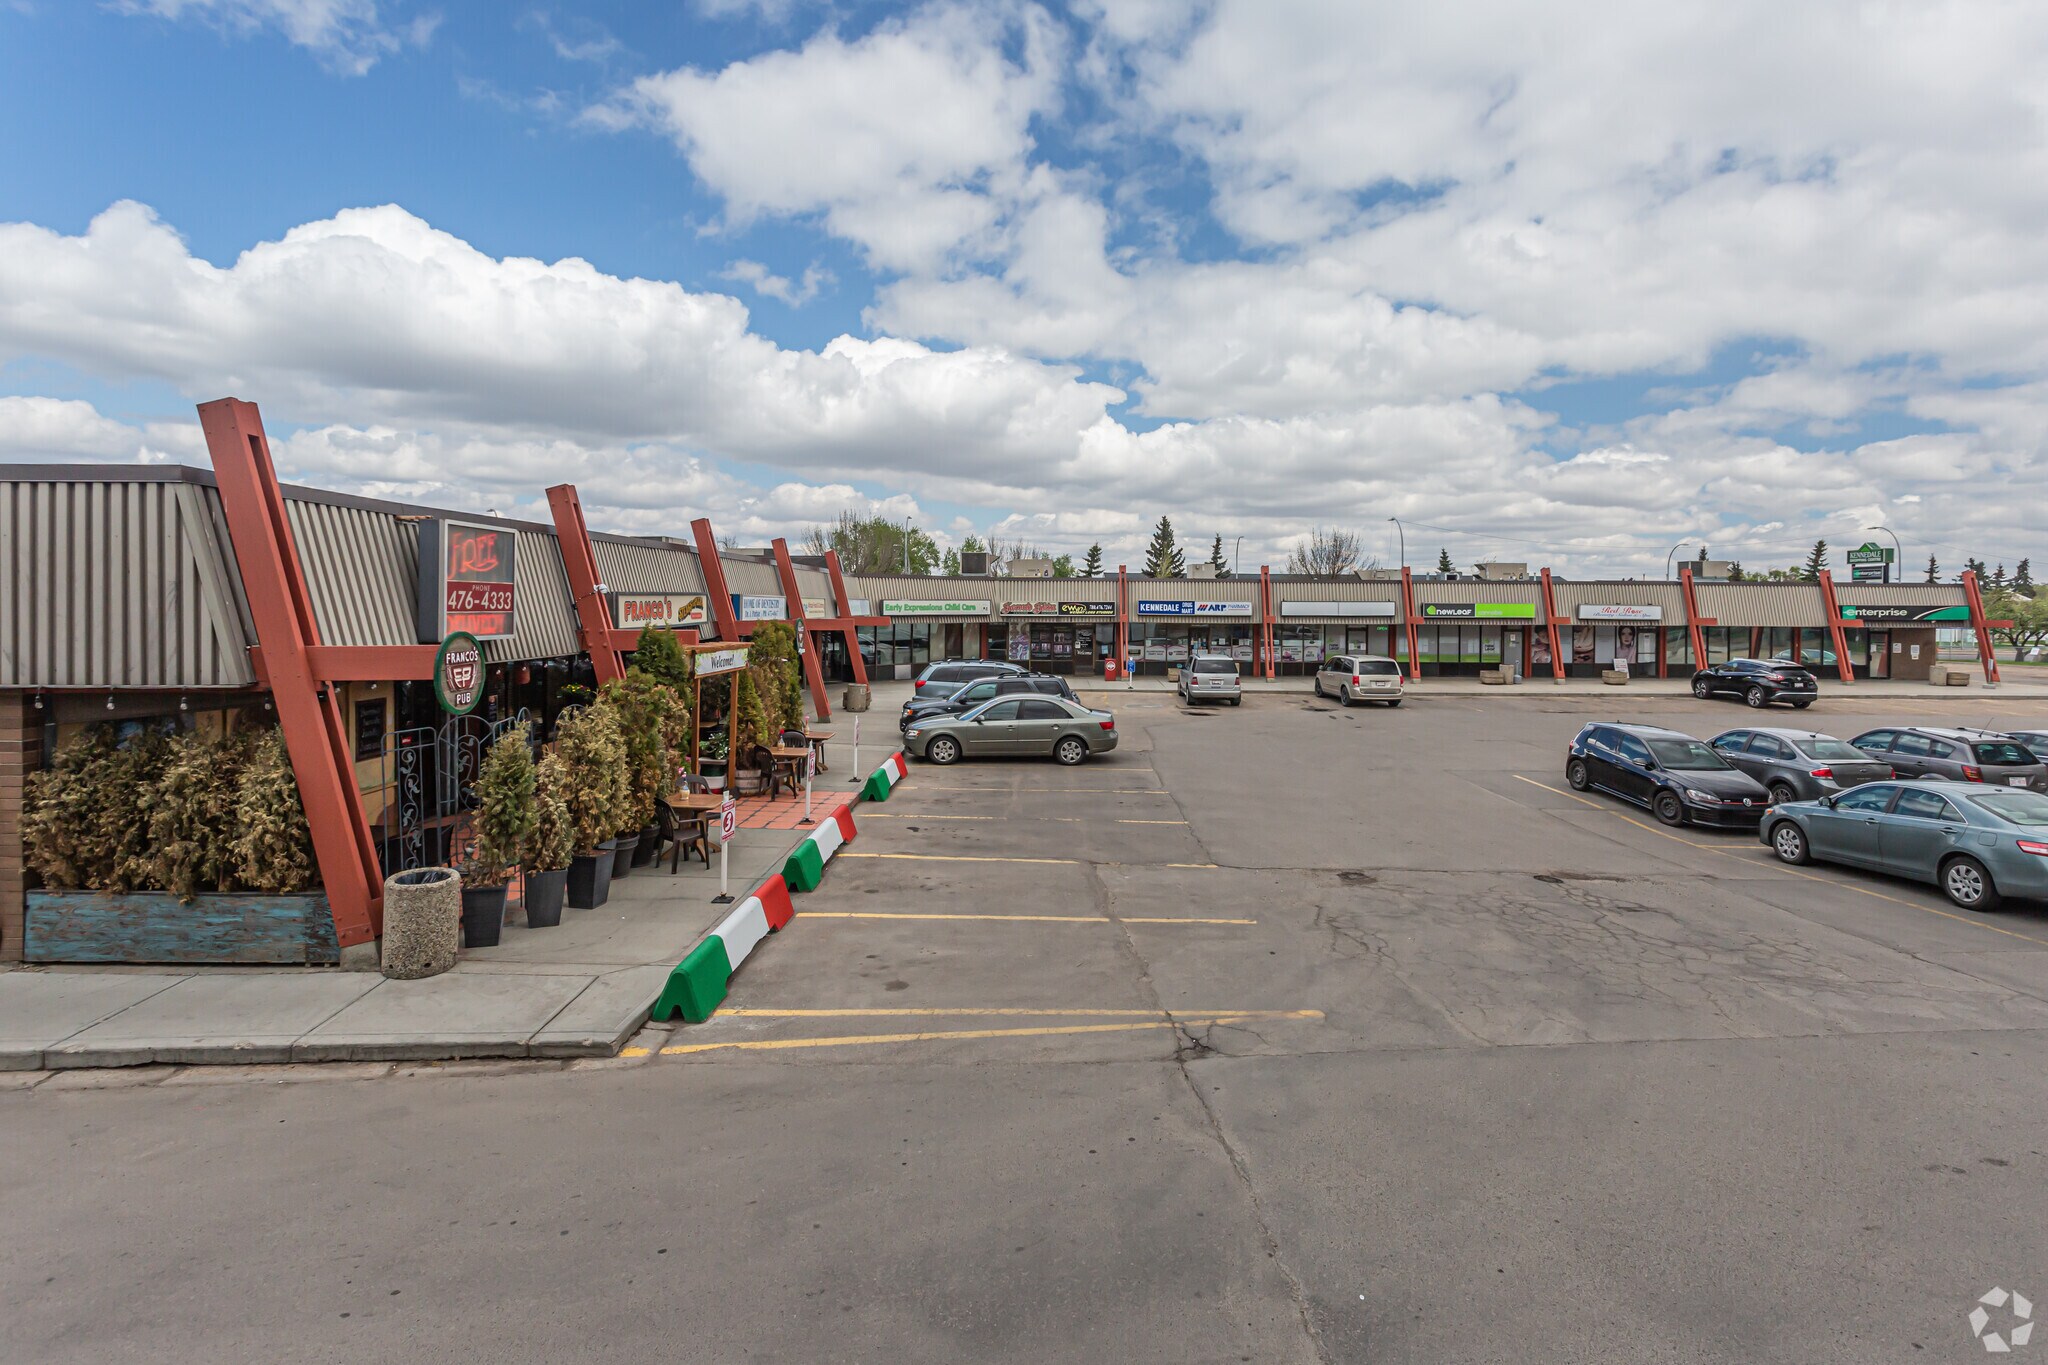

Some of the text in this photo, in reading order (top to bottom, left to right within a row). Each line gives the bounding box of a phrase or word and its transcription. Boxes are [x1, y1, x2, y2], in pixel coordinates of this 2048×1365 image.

[1849, 551, 1882, 559] KENNEDALE
[472, 584, 491, 592] PHONE
[448, 590, 512, 610] 476-4333
[624, 596, 672, 622] FRANCO'S
[885, 604, 903, 612] Early
[904, 604, 943, 612] Expressions
[944, 603, 961, 611] Child
[962, 603, 977, 611] Care
[1140, 603, 1180, 612] KENNEDALE
[1208, 604, 1227, 612] ARP
[1601, 606, 1643, 614] Red Rose
[1846, 608, 1908, 618] enterprise
[446, 646, 479, 664] FRANCO'S
[456, 693, 471, 705] PUB
